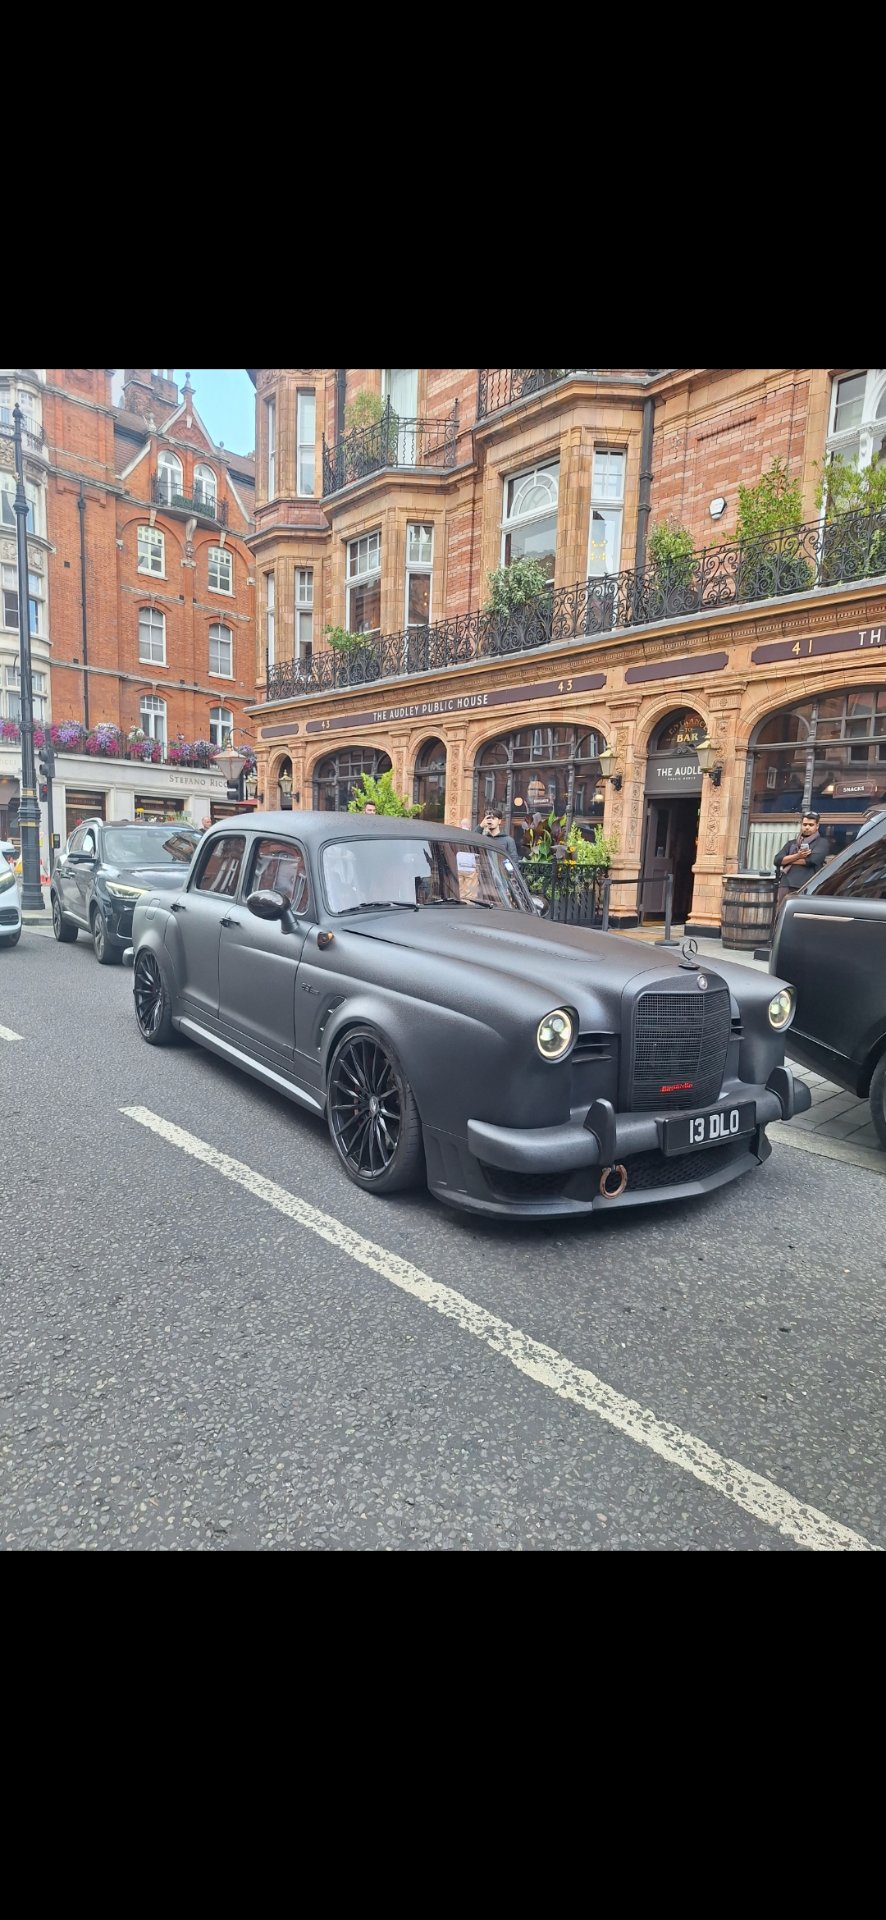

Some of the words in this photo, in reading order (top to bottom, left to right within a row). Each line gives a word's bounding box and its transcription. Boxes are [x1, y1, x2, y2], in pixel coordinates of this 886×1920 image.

[859, 629, 886, 646] TH
[791, 639, 813, 655] 41
[558, 680, 573, 692] 43
[373, 711, 387, 721] THE
[389, 705, 419, 719] AUDLEY
[422, 700, 454, 714] PUBLIC
[457, 694, 489, 709] HOUSE
[321, 720, 330, 729] 43
[676, 733, 699, 743] BAR
[656, 767, 673, 777] THE
[674, 765, 703, 776] AUDLE
[169, 774, 206, 786] STEFANO
[210, 778, 228, 788] RICC
[842, 785, 865, 793] SNACKS
[689, 1117, 705, 1144] 13
[709, 1109, 740, 1139] DLO
